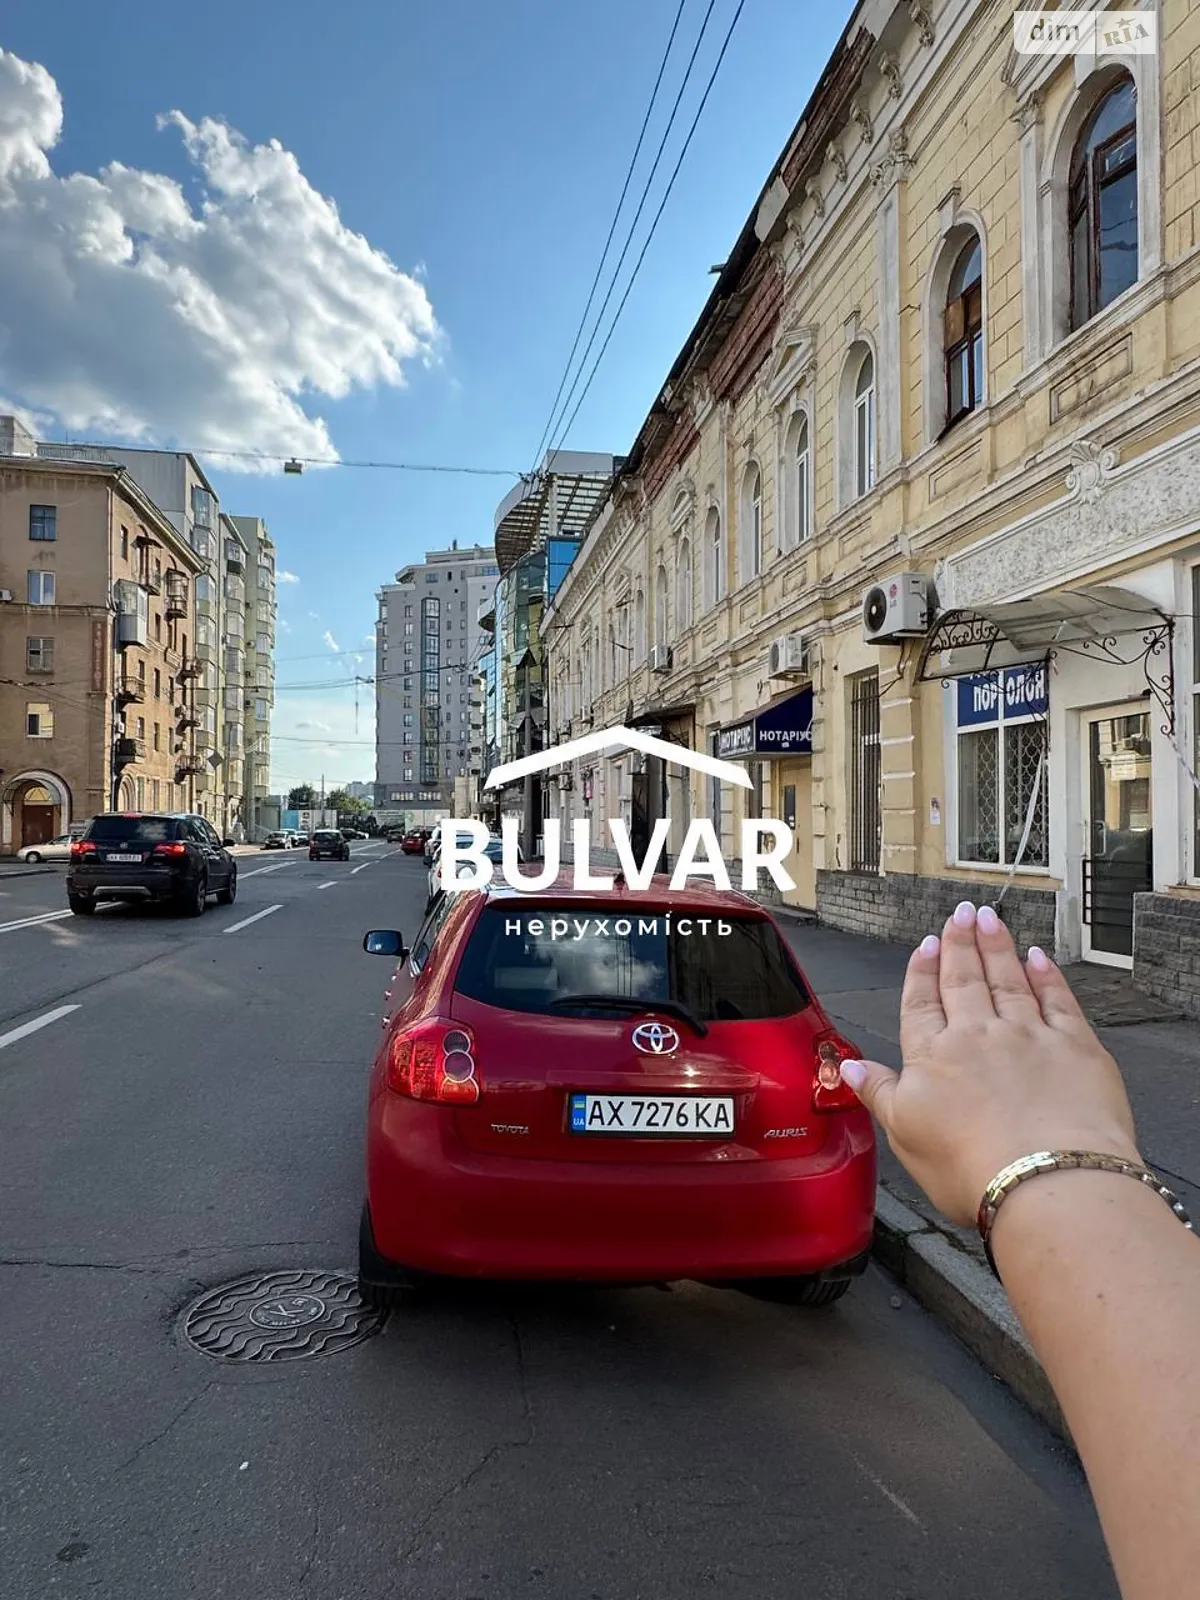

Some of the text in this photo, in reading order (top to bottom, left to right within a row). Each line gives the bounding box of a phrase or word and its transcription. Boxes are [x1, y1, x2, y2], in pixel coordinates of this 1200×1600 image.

[573, 1100, 730, 1128] UA AX 7276 KA
[763, 1126, 808, 1139] AURIS
